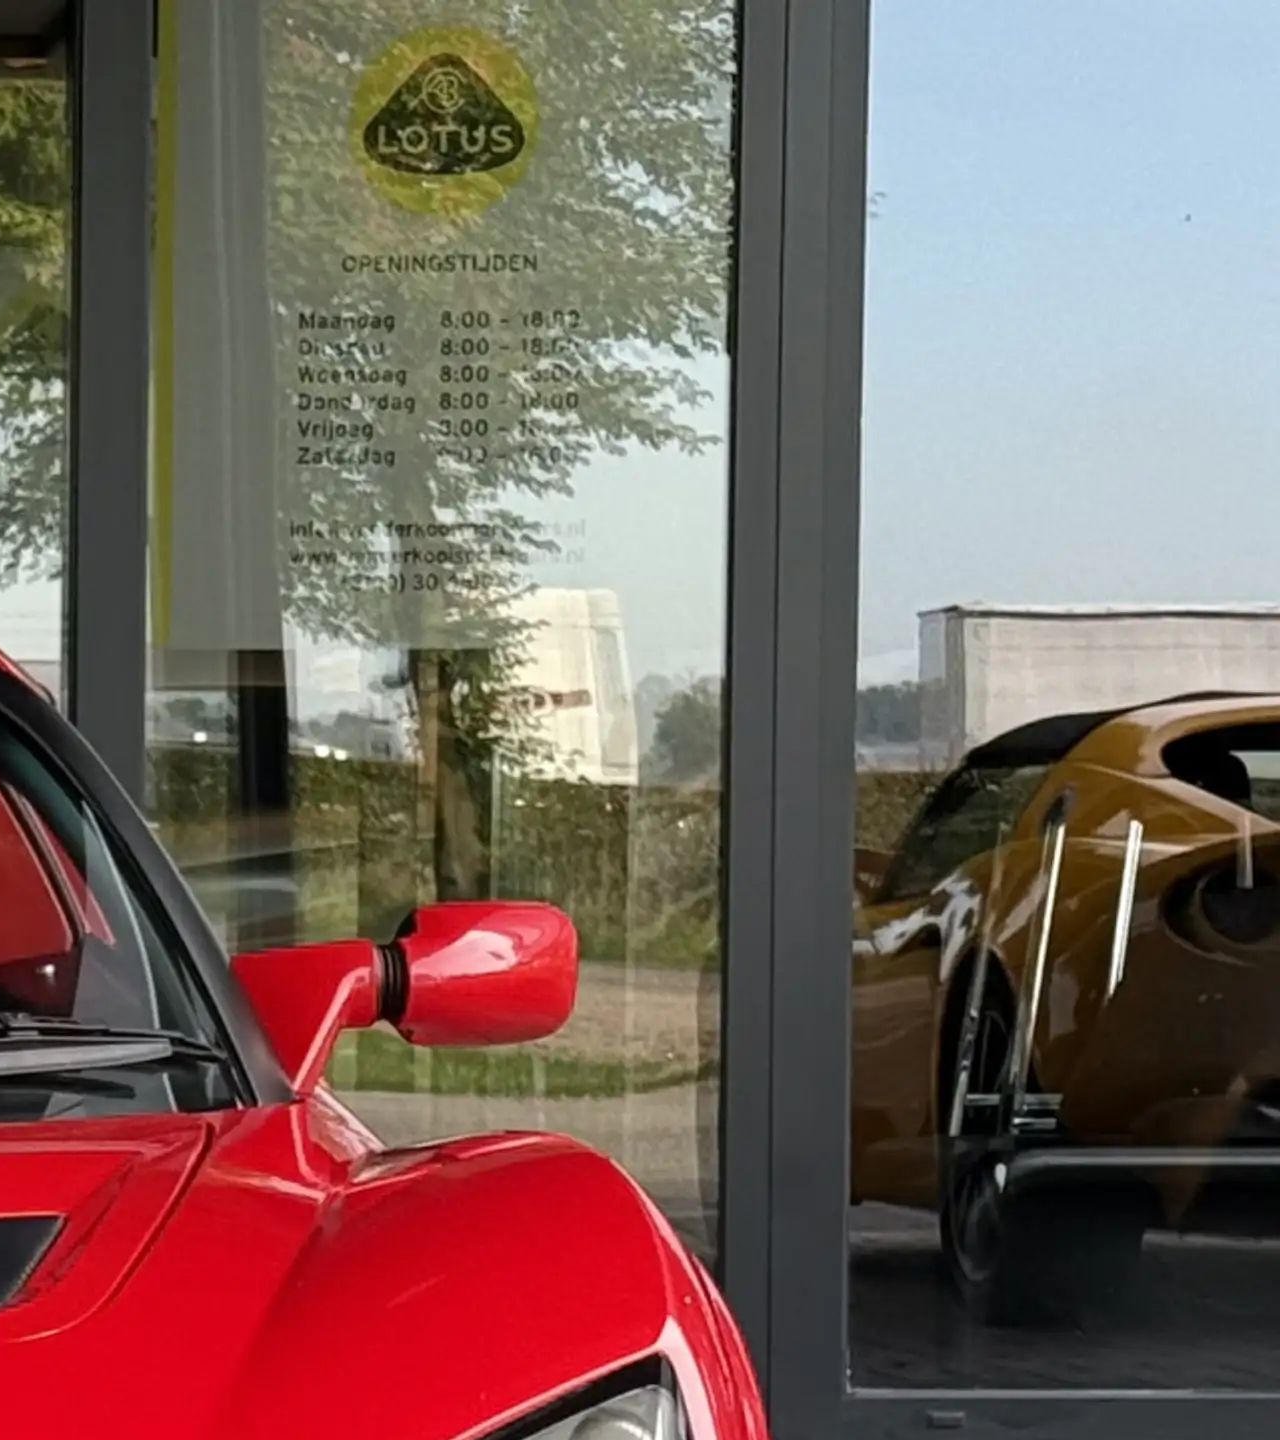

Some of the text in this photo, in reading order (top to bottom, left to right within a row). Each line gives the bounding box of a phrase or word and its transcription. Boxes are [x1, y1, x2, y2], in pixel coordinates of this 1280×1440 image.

[378, 123, 516, 155] LOTUS
[341, 254, 538, 274] OPENINGSTIJDEN
[298, 311, 396, 334] Maandag
[440, 310, 490, 329] 8:00
[440, 337, 490, 356] 8:00
[521, 337, 580, 356] 18:0
[439, 365, 490, 383] 8:00
[297, 392, 416, 414] Dondrdag
[439, 391, 489, 410] 8:00
[413, 573, 438, 591] 30
